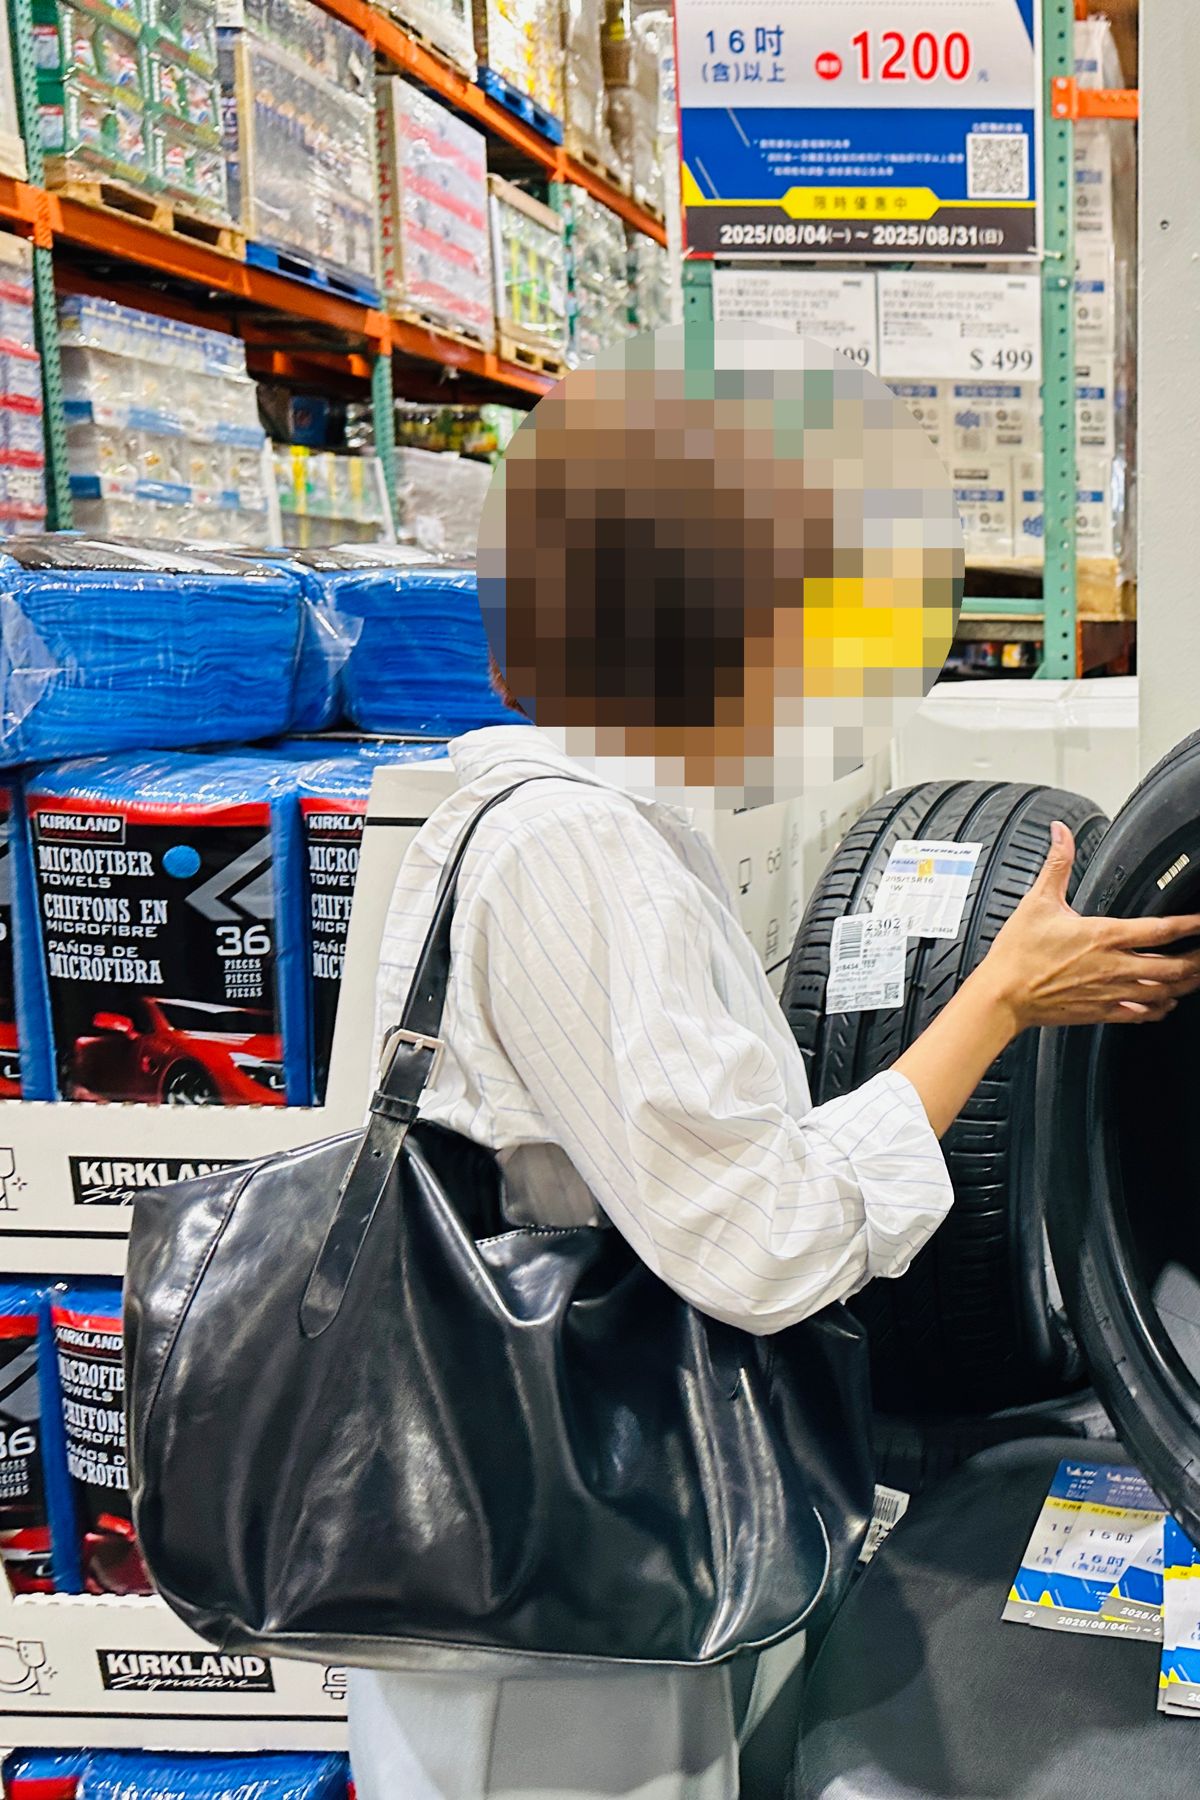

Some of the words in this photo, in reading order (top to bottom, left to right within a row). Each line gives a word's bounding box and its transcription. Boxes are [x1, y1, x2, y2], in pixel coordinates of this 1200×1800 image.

[705, 25, 785, 57] 16吋
[851, 29, 971, 81] 1200
[701, 61, 786, 83] (含)以上
[969, 348, 983, 371] $
[991, 348, 1033, 372] 499
[39, 814, 121, 833] KIRKLAND
[37, 845, 155, 877] MICROFIBER
[40, 872, 112, 889] TOWELS
[43, 893, 131, 924] CHIFFONS
[139, 899, 169, 925] EN
[46, 920, 159, 938] MICROFIBRE
[215, 924, 271, 957] 36
[112, 946, 140, 959] DE
[48, 952, 165, 985] MICROFIBRA
[106, 1653, 266, 1677] KIRKLAND
[110, 1673, 269, 1692] Signature
